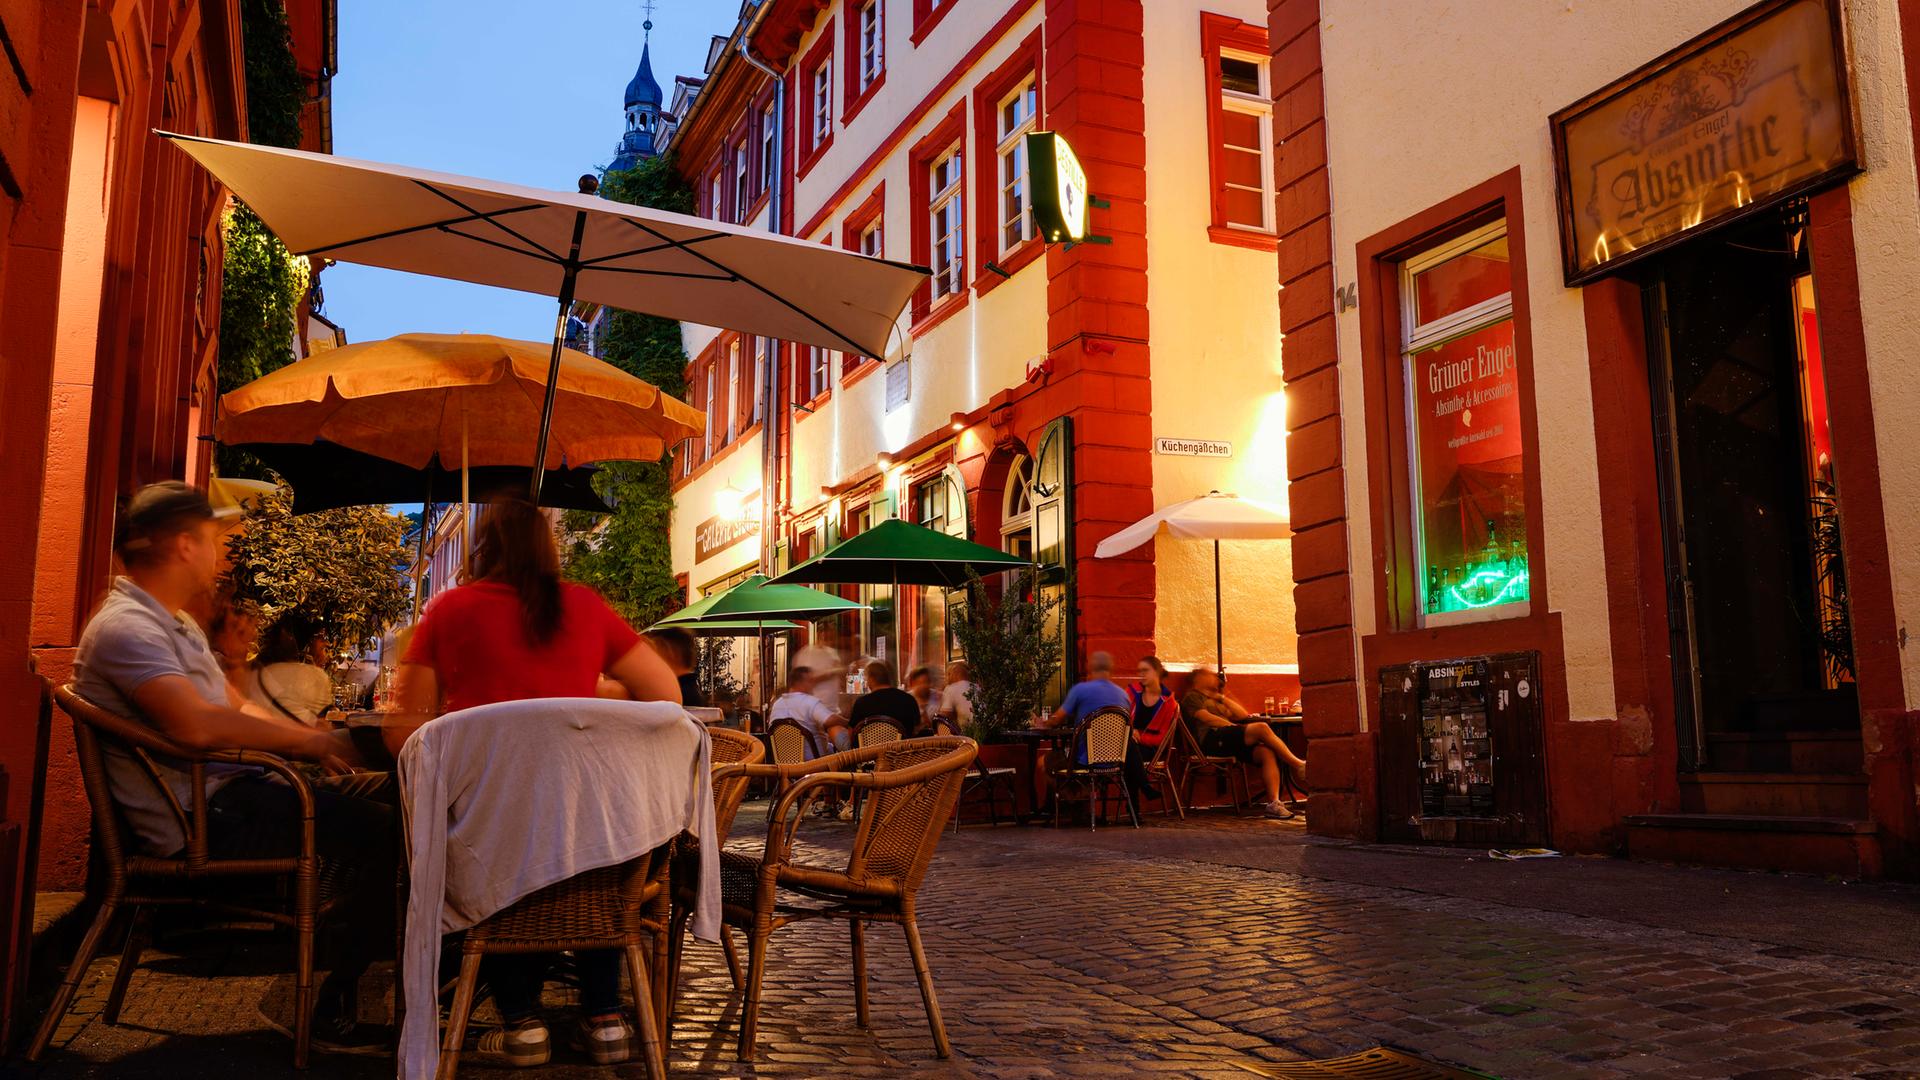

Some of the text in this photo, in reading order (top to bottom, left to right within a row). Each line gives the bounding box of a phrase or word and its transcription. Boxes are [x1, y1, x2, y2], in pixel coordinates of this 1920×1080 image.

[1611, 114, 1780, 221] Absinthe
[1336, 282, 1357, 313] 14
[1428, 341, 1517, 394] Grüner Engel
[1435, 394, 1465, 417] Absinthe
[1466, 390, 1472, 408] &
[1161, 440, 1229, 456] Küchengäßchen
[1428, 664, 1474, 679] ABSINTHE
[1460, 680, 1480, 688] STYLES
